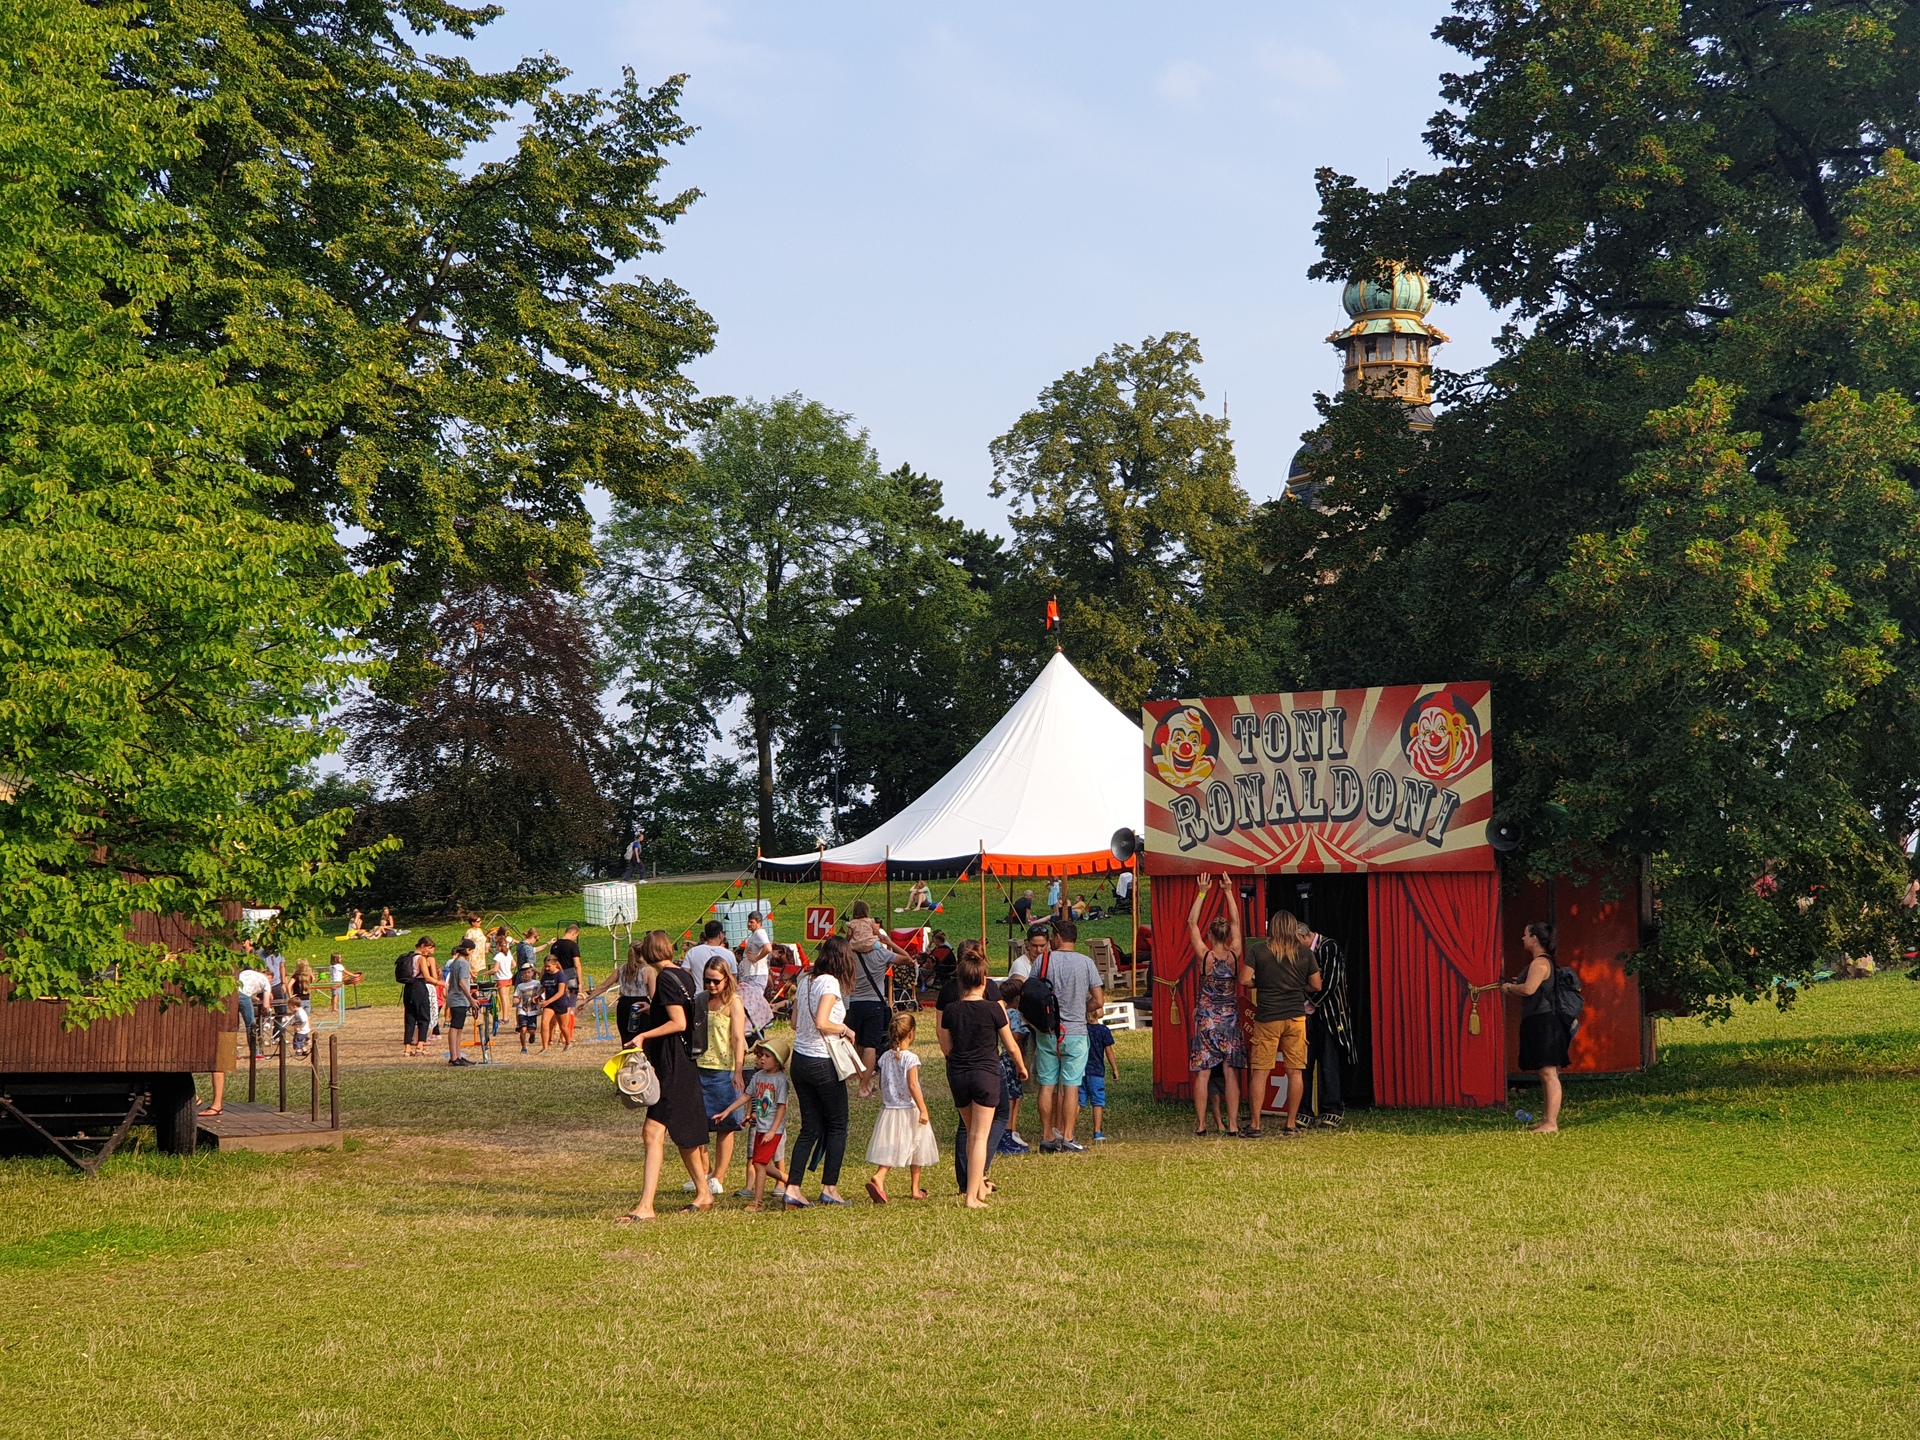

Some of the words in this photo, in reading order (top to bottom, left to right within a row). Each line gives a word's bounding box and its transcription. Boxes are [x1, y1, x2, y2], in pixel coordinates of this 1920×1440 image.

[1231, 706, 1347, 765] TONI
[1168, 765, 1461, 851] RONALDONI
[808, 909, 834, 937] 14
[1270, 1073, 1289, 1109] 7
